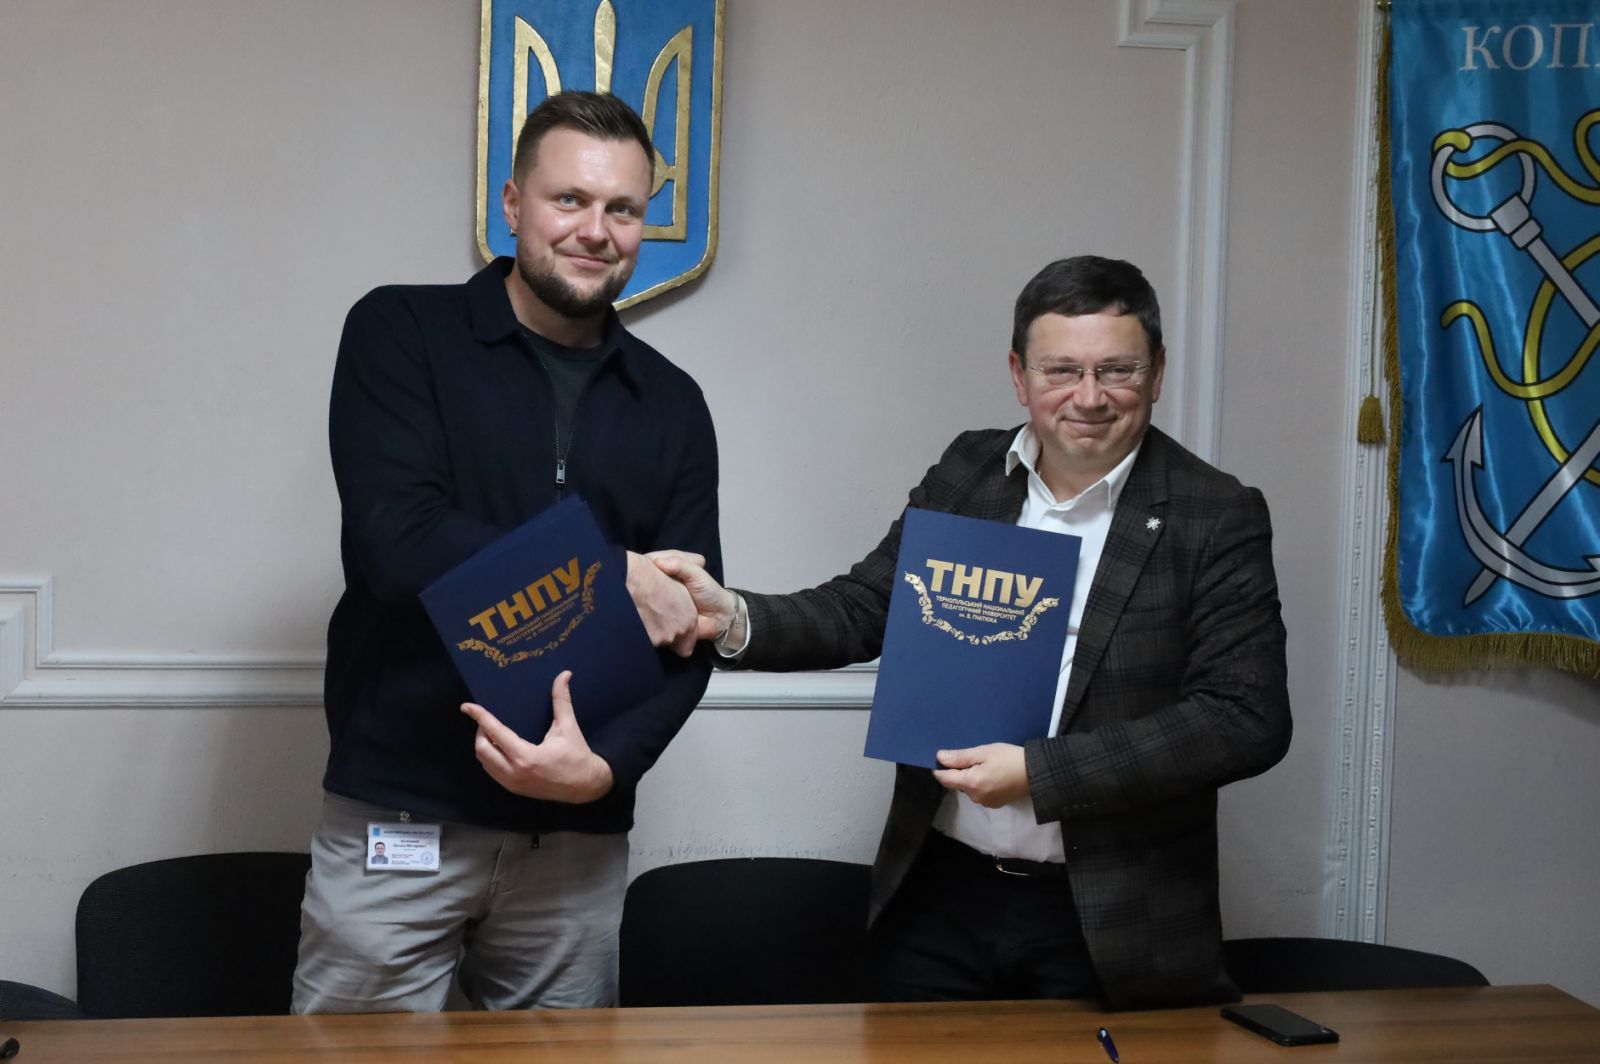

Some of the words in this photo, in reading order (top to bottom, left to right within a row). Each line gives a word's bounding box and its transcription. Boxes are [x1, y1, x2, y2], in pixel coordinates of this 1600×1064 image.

[1459, 23, 1600, 71] КОП
[468, 556, 581, 640] ТНПУ
[926, 558, 1044, 608] ТНПУ
[935, 595, 982, 608] ТЕРНОПІЛЬСЬКИЙ
[981, 609, 1016, 620] УНІВЕРСИТЕТ
